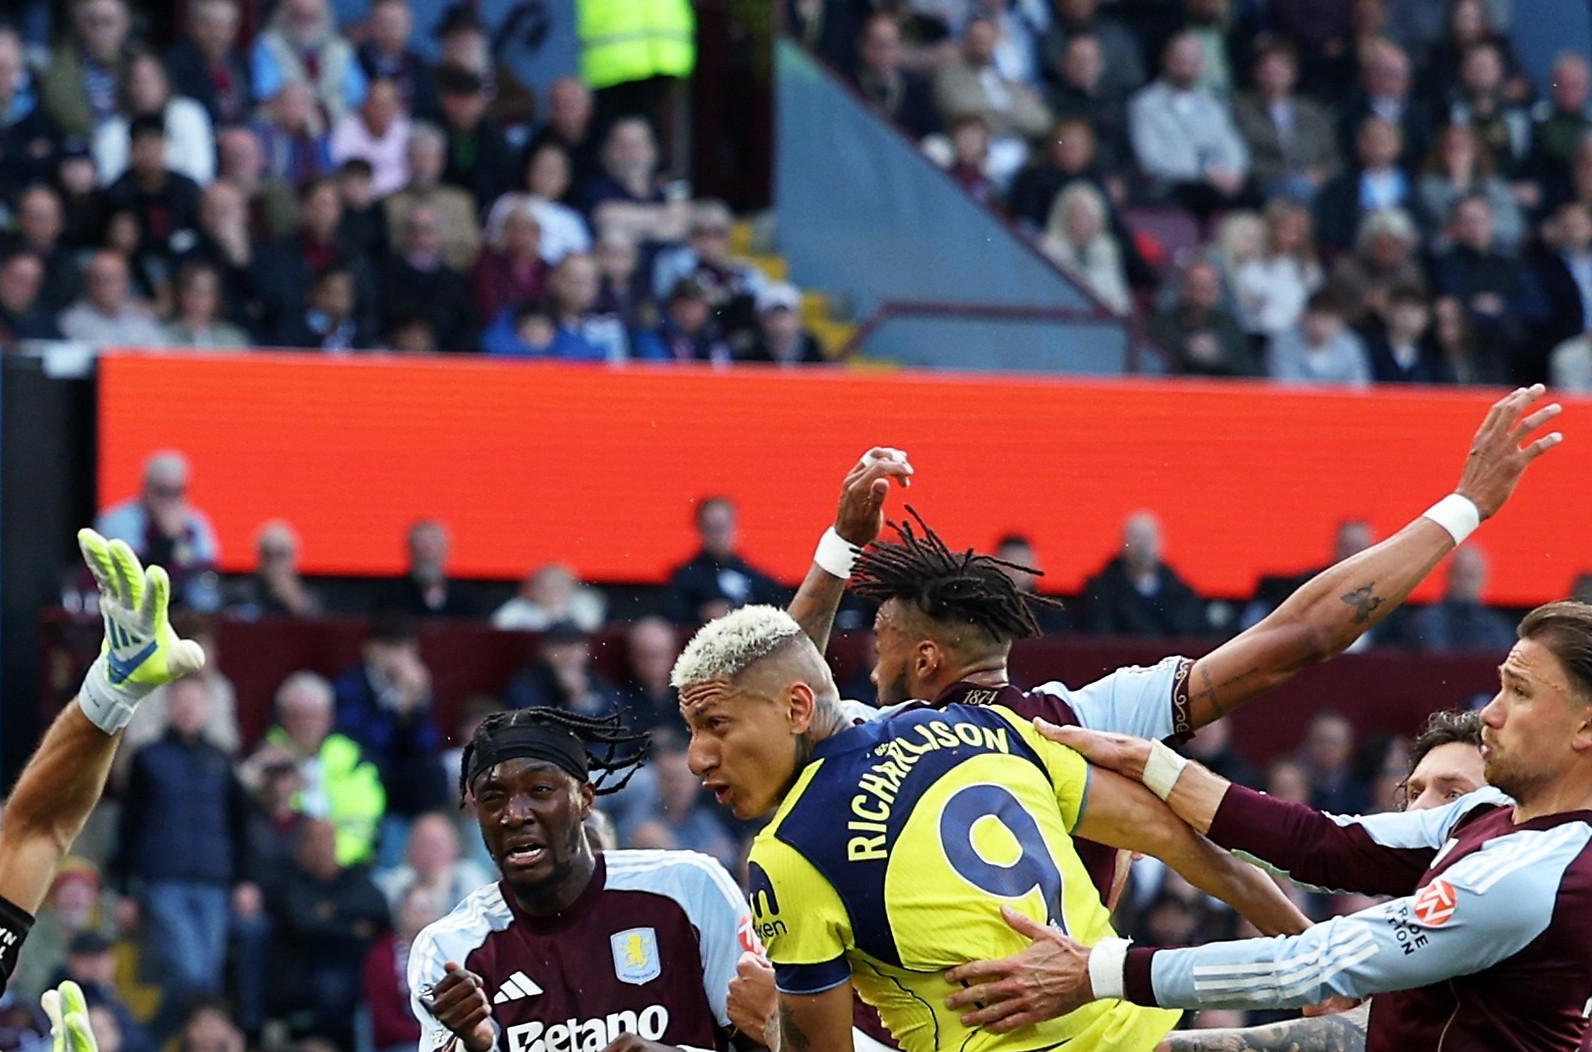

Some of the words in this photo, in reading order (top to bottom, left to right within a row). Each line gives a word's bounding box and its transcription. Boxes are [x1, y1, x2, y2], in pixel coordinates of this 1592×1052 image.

[848, 721, 1010, 862] RICHARLISON
[937, 781, 1072, 937] 9
[758, 920, 788, 938] ken
